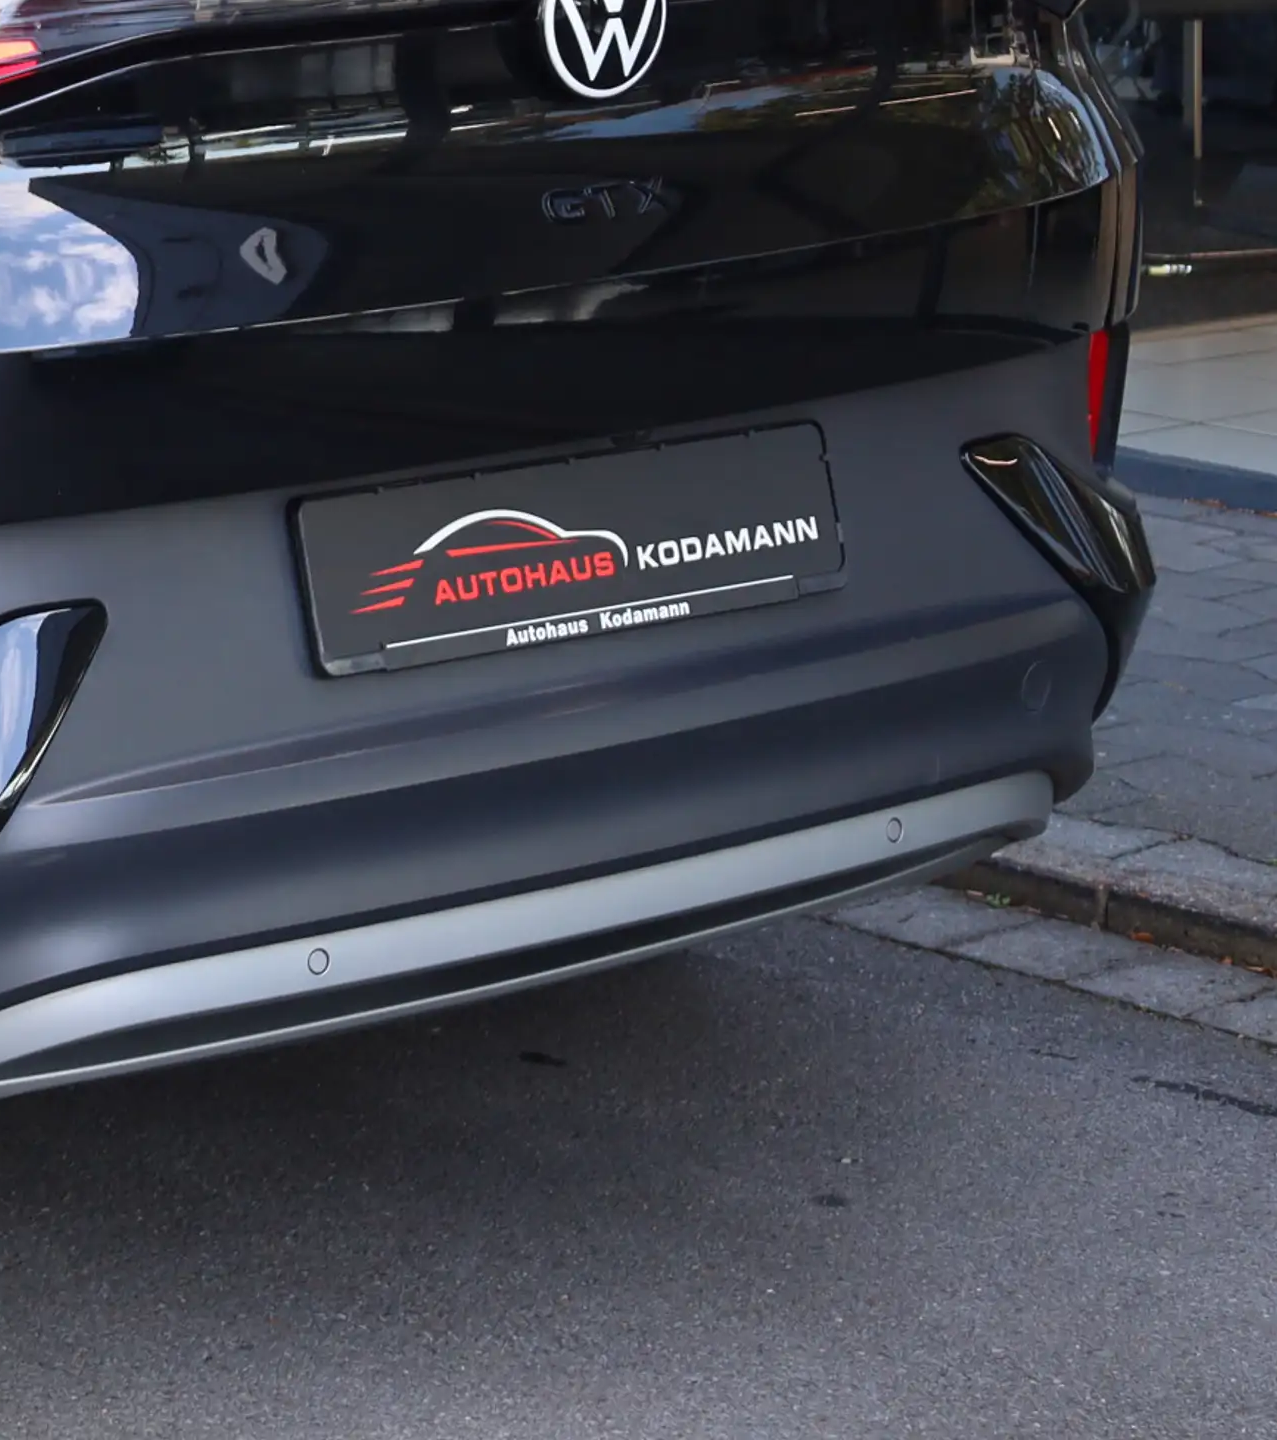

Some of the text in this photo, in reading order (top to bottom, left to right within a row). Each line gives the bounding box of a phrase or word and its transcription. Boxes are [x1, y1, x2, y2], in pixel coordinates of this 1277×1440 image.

[541, 177, 663, 223] GTX
[434, 516, 819, 606] AUTOHAUS KODAMANN
[506, 600, 690, 647] Autohaus Kodamann
